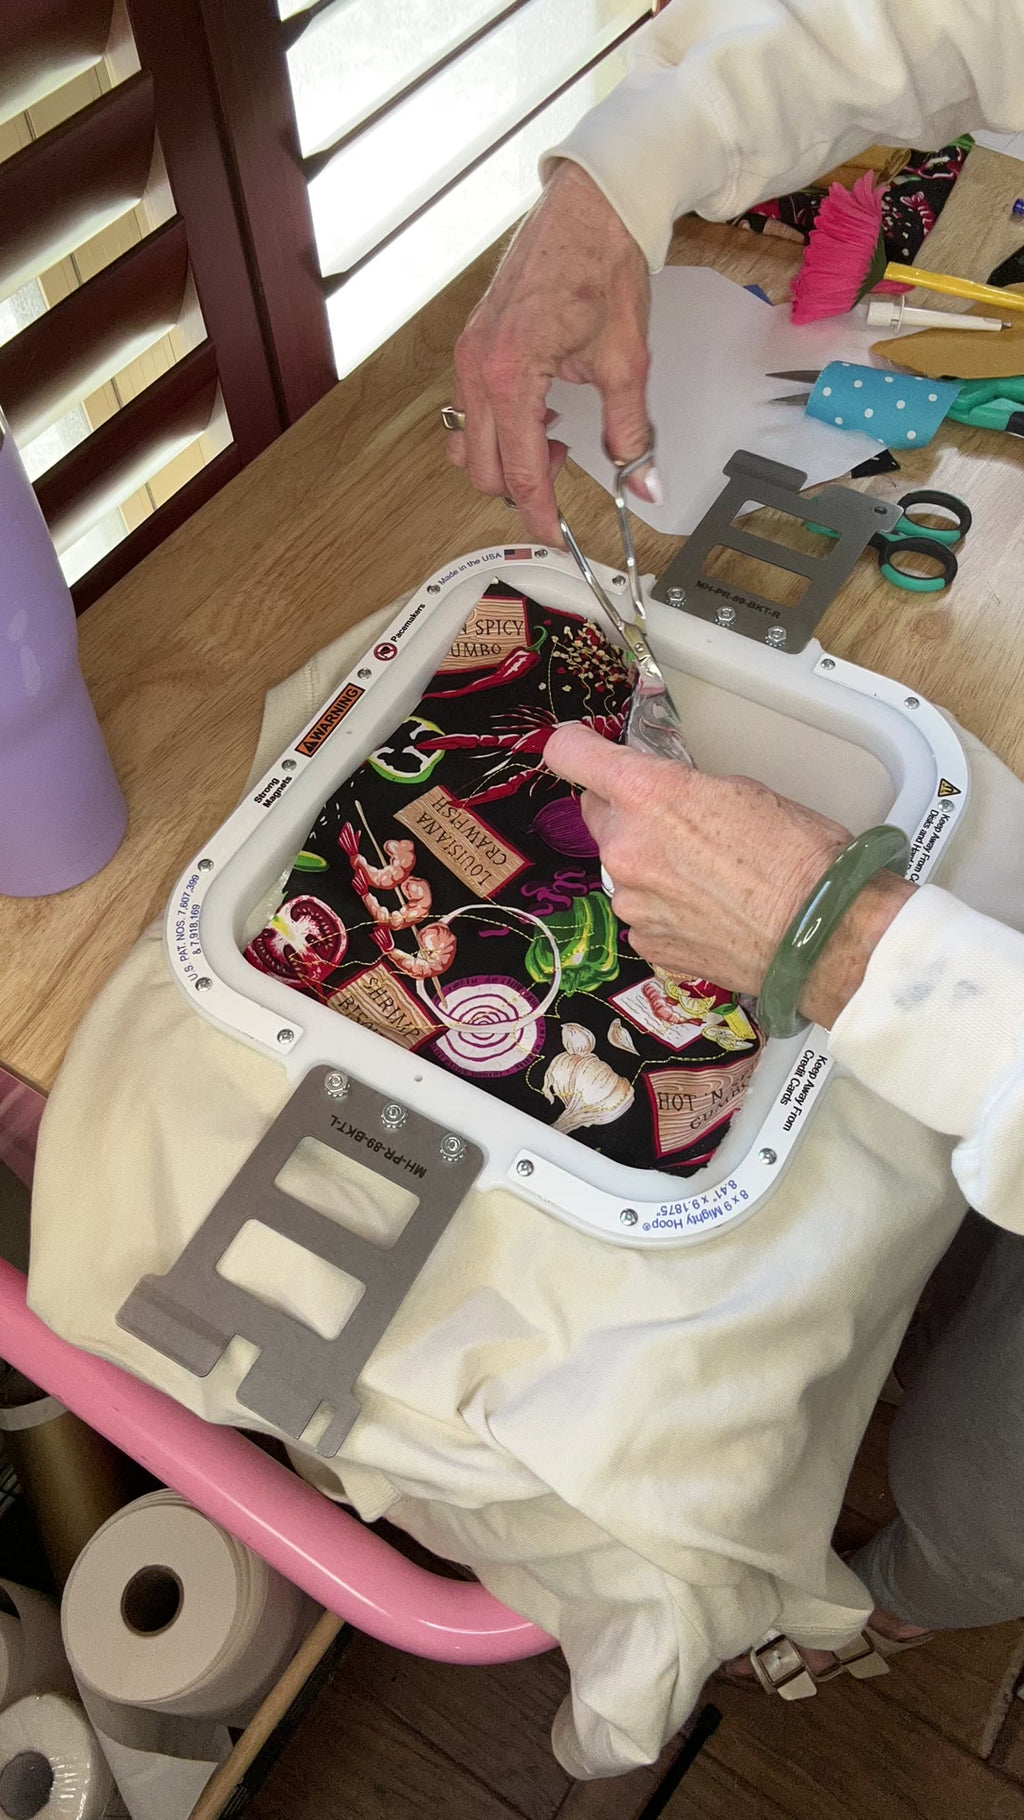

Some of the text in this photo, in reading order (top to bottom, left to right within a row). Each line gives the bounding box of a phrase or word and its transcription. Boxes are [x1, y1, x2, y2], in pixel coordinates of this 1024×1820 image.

[438, 552, 502, 586] Made in the USA
[391, 603, 426, 642] Pacemakers
[475, 619, 524, 635] SPICY
[451, 643, 502, 658] UMBO
[310, 688, 359, 742] WARNING
[254, 778, 280, 803] Strong
[263, 776, 292, 808] Magnets
[923, 809, 939, 829] Disks
[934, 814, 951, 832] Keep
[431, 796, 507, 865] CRAWFISH
[915, 829, 927, 845] and
[416, 812, 492, 886] LOUISIANA
[924, 832, 940, 853] Away
[914, 853, 930, 873] From
[176, 874, 200, 981] U.S. PAT. NOS. 7,607,399
[189, 904, 201, 947] 7,918,169
[363, 977, 420, 1038] SHRIMP
[780, 1049, 815, 1106] Credit Cards
[657, 1092, 695, 1111] HOT
[783, 1055, 828, 1132] Keep Away From
[330, 1114, 428, 1179] MH-PR-89-BKT-L
[701, 1195, 709, 1205] x
[731, 1195, 740, 1204] x
[739, 1190, 749, 1200] 8
[656, 1199, 700, 1217] 9.1875"
[686, 1206, 723, 1225] Mighty
[723, 1201, 732, 1211] 9
